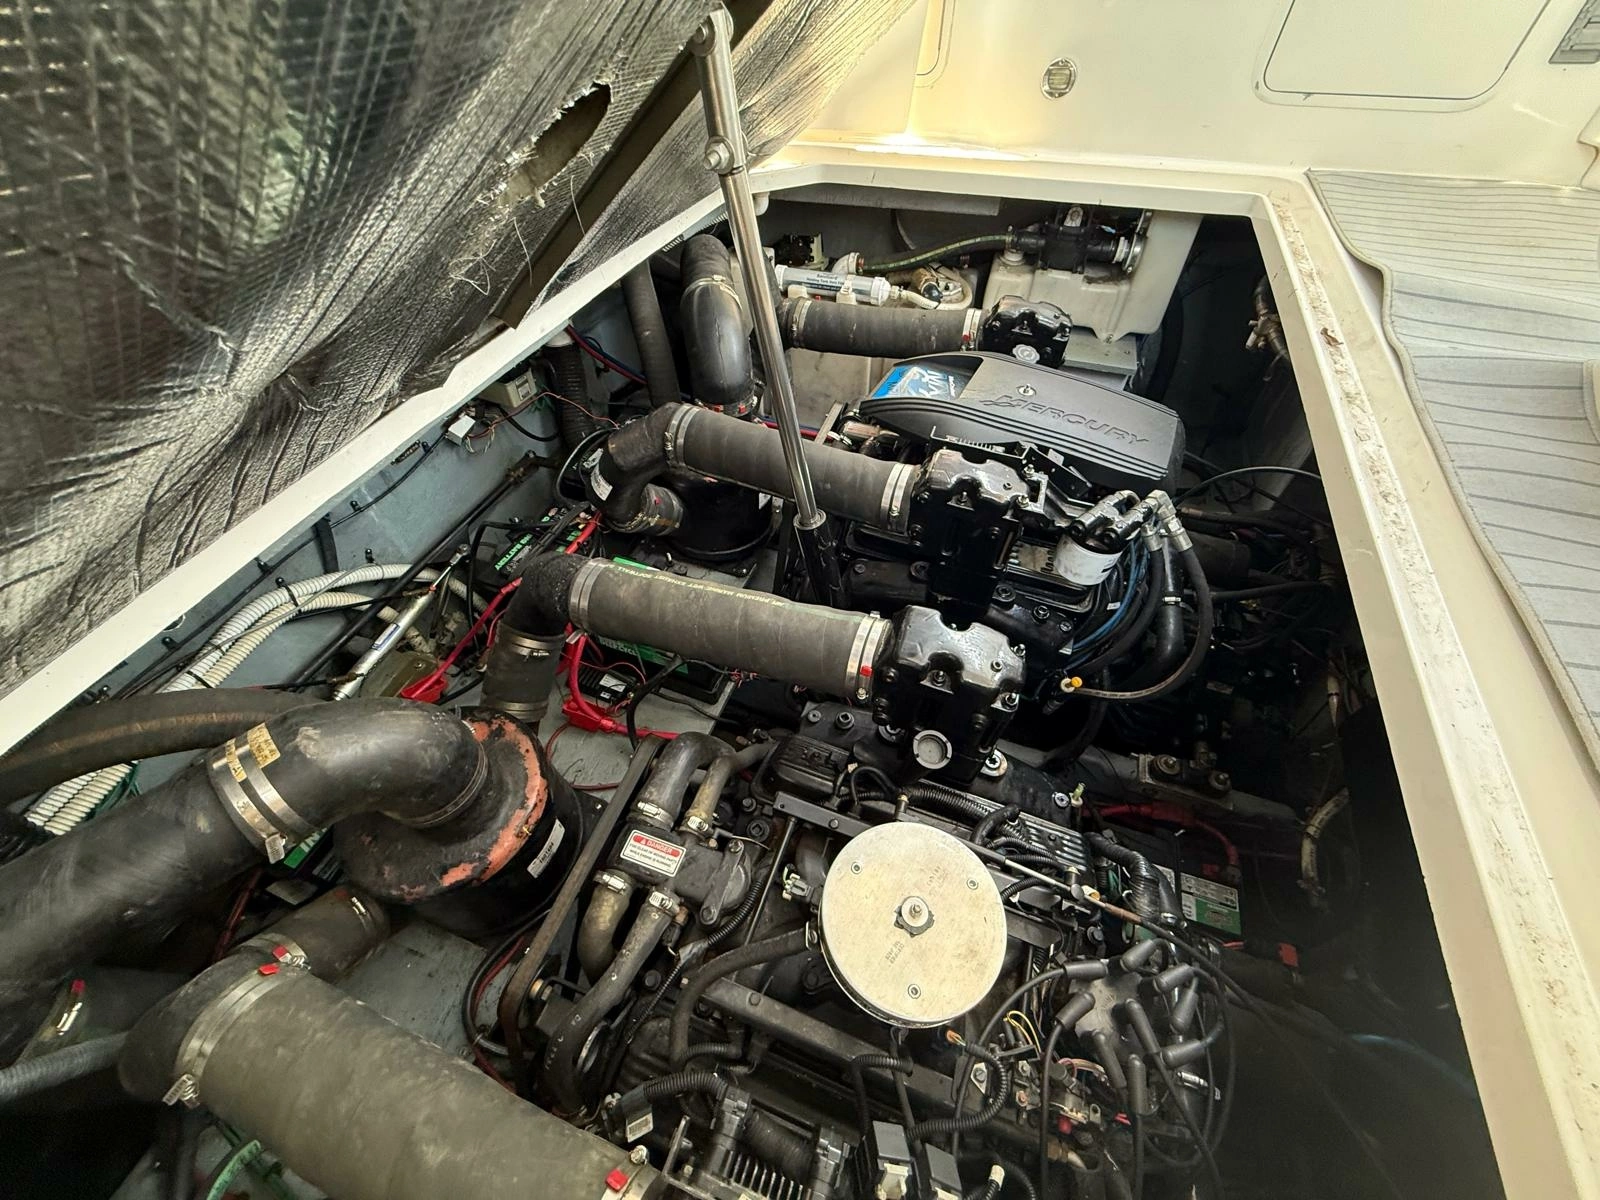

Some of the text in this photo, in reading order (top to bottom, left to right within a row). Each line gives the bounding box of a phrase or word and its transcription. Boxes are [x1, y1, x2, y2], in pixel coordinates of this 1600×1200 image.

[979, 394, 1149, 444] MERCURY
[493, 542, 523, 571] BATTERY
[646, 840, 674, 855] DANGER
